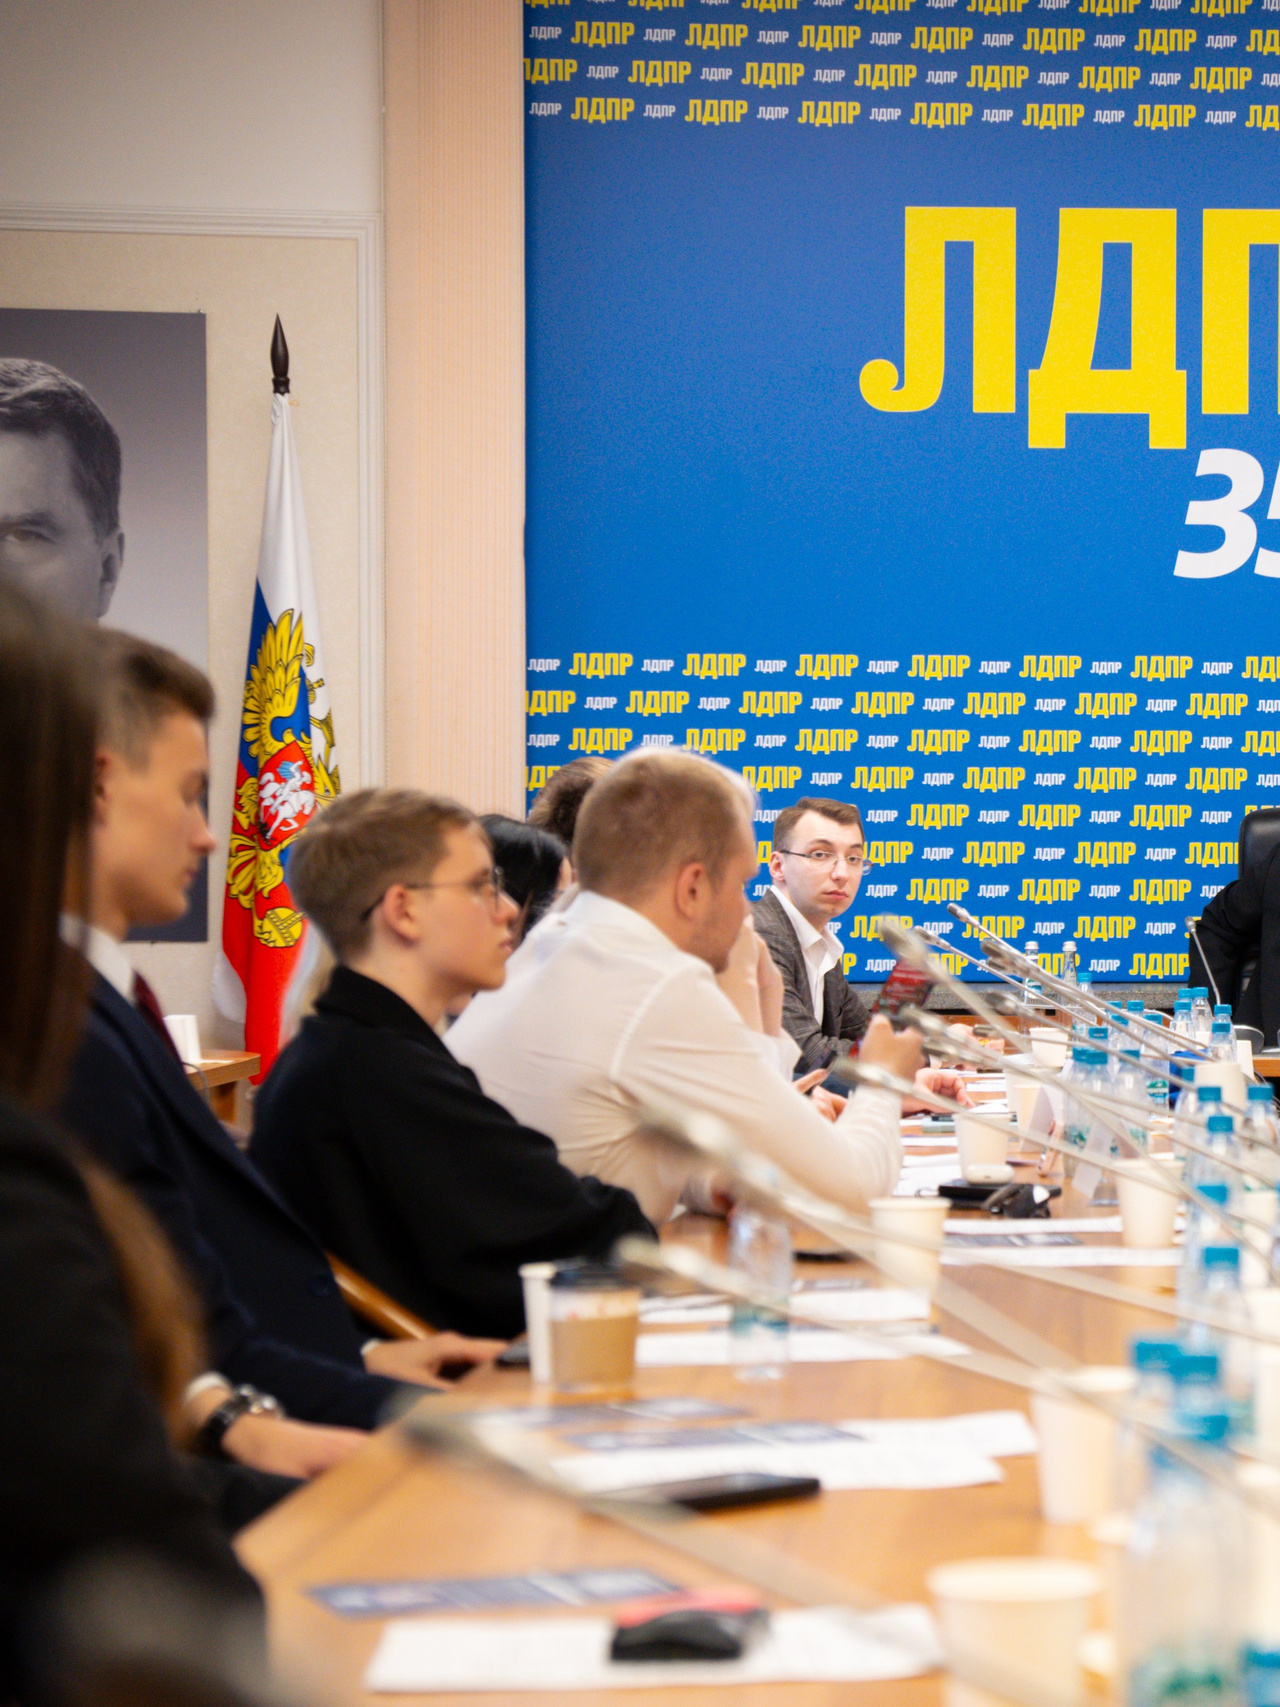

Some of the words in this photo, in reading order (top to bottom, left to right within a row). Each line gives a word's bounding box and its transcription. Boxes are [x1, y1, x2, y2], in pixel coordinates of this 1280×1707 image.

[531, 27, 561, 39] ЛДПР
[571, 22, 634, 47] ЛДПР
[644, 29, 675, 42] ЛДПР
[685, 23, 748, 50] ЛДПР
[757, 31, 789, 44] ЛДПР
[798, 25, 861, 51] ЛДПР
[870, 32, 901, 46] ЛДПР
[911, 27, 973, 53] ЛДПР
[982, 34, 1013, 47] ЛДПР
[1023, 28, 1085, 54] ЛДПР
[1094, 35, 1125, 48] ЛДПР
[1134, 29, 1196, 55] ЛДПР
[1206, 36, 1237, 49] ЛДПР
[530, 103, 561, 116] ЛДПР
[571, 97, 634, 123] ЛДПР
[644, 105, 675, 118] ЛДПР
[685, 99, 748, 125] ЛДПР
[757, 106, 789, 120] ЛДПР
[798, 101, 861, 127] ЛДПР
[869, 108, 901, 122] ЛДПР
[910, 102, 973, 128] ЛДПР
[982, 109, 1013, 123] ЛДПР
[1022, 103, 1084, 130] ЛДПР
[1093, 110, 1125, 124] ЛДПР
[1134, 104, 1196, 130] ЛДПР
[1205, 111, 1236, 124] ЛДПР
[527, 658, 560, 672] ЛДПР
[569, 653, 633, 679] ЛДПР
[642, 659, 674, 673] ЛДПР
[682, 653, 746, 679] ЛДПР
[754, 660, 787, 673] ЛДПР
[795, 654, 858, 680] ЛДПР
[867, 661, 899, 674] ЛДПР
[907, 655, 970, 680] ЛДПР
[979, 661, 1011, 674] ЛДПР
[1019, 655, 1082, 681] ЛДПР
[1090, 662, 1122, 675] ЛДПР
[1130, 656, 1193, 681] ЛДПР
[1201, 662, 1233, 675] ЛДПР
[625, 691, 689, 717] ЛДПР
[739, 691, 802, 717] ЛДПР
[851, 692, 914, 718] ЛДПР
[963, 692, 1026, 718] ЛДПР
[1075, 693, 1137, 718] ЛДПР
[1186, 693, 1248, 719] ЛДПР
[527, 734, 560, 748] ЛДПР
[568, 728, 633, 754] ЛДПР
[682, 728, 746, 754] ЛДПР
[754, 735, 786, 748] ЛДПР
[795, 729, 858, 754] ЛДПР
[867, 735, 898, 748] ЛДПР
[907, 729, 970, 755] ЛДПР
[978, 736, 1010, 749] ЛДПР
[1019, 730, 1081, 755] ЛДПР
[1090, 736, 1121, 750] ЛДПР
[1130, 730, 1192, 756] ЛДПР
[1201, 737, 1232, 750] ЛДПР
[740, 766, 802, 792] ЛДПР
[810, 773, 842, 786] ЛДПР
[851, 766, 914, 792] ЛДПР
[922, 773, 954, 786] ЛДПР
[963, 767, 1025, 793] ЛДПР
[1034, 773, 1065, 786] ЛДПР
[1074, 767, 1137, 793] ЛДПР
[1145, 774, 1177, 787] ЛДПР
[1185, 768, 1247, 793] ЛДПР
[866, 810, 898, 823] ЛДПР
[906, 804, 969, 830] ЛДПР
[978, 811, 1009, 824] ЛДПР
[1018, 804, 1081, 830] ЛДПР
[1089, 811, 1121, 824] ЛДПР
[1129, 805, 1192, 830] ЛДПР
[1200, 811, 1232, 824] ЛДПР
[922, 848, 954, 860] ЛДПР
[962, 841, 1025, 867] ЛДПР
[1033, 848, 1065, 861] ЛДПР
[1074, 842, 1136, 867] ЛДПР
[1145, 848, 1176, 861] ЛДПР
[866, 885, 897, 898] ЛДПР
[906, 879, 969, 904] ЛДПР
[978, 885, 1009, 898] ЛДПР
[1018, 879, 1080, 904] ЛДПР
[1089, 885, 1120, 898] ЛДПР
[1129, 879, 1191, 904] ЛДПР
[962, 916, 1025, 942] ЛДПР
[1033, 922, 1064, 935] ЛДПР
[1073, 916, 1136, 942] ЛДПР
[1145, 923, 1176, 935] ЛДПР
[1089, 960, 1120, 972] ЛДПР
[1129, 953, 1190, 979] ЛДПР
